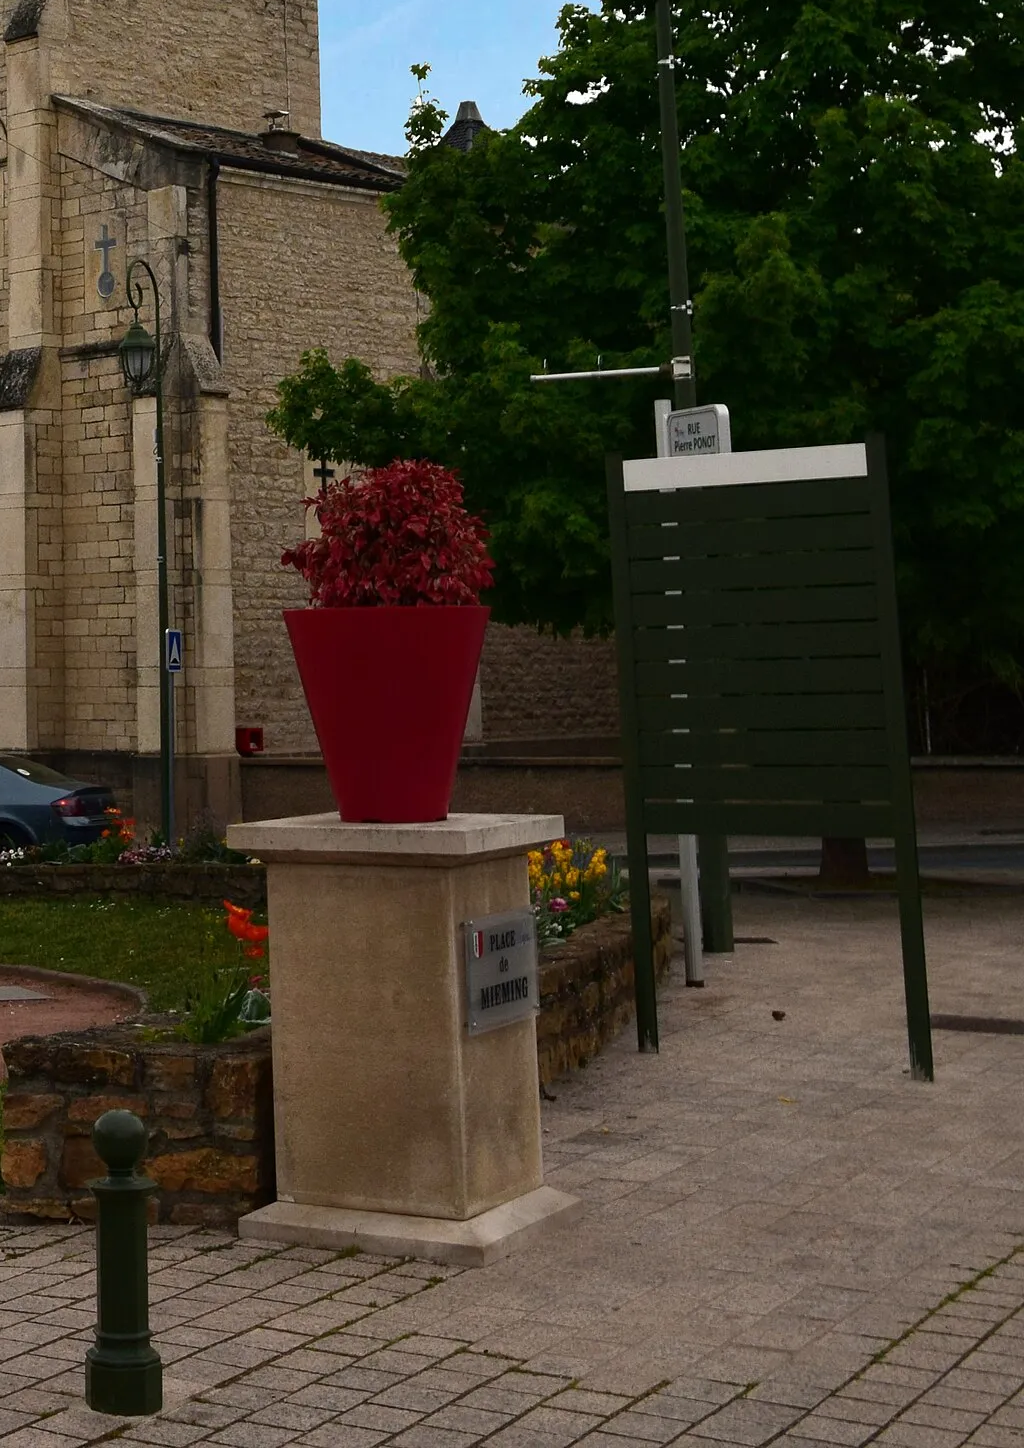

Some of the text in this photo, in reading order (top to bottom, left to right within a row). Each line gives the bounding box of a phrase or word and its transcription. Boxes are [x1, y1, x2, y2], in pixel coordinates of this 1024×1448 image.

[688, 422, 700, 435] RUE
[674, 435, 715, 452] Pierre PONOT
[489, 930, 516, 952] PLACE
[499, 956, 509, 972] de
[480, 976, 529, 1010] MIEMING
